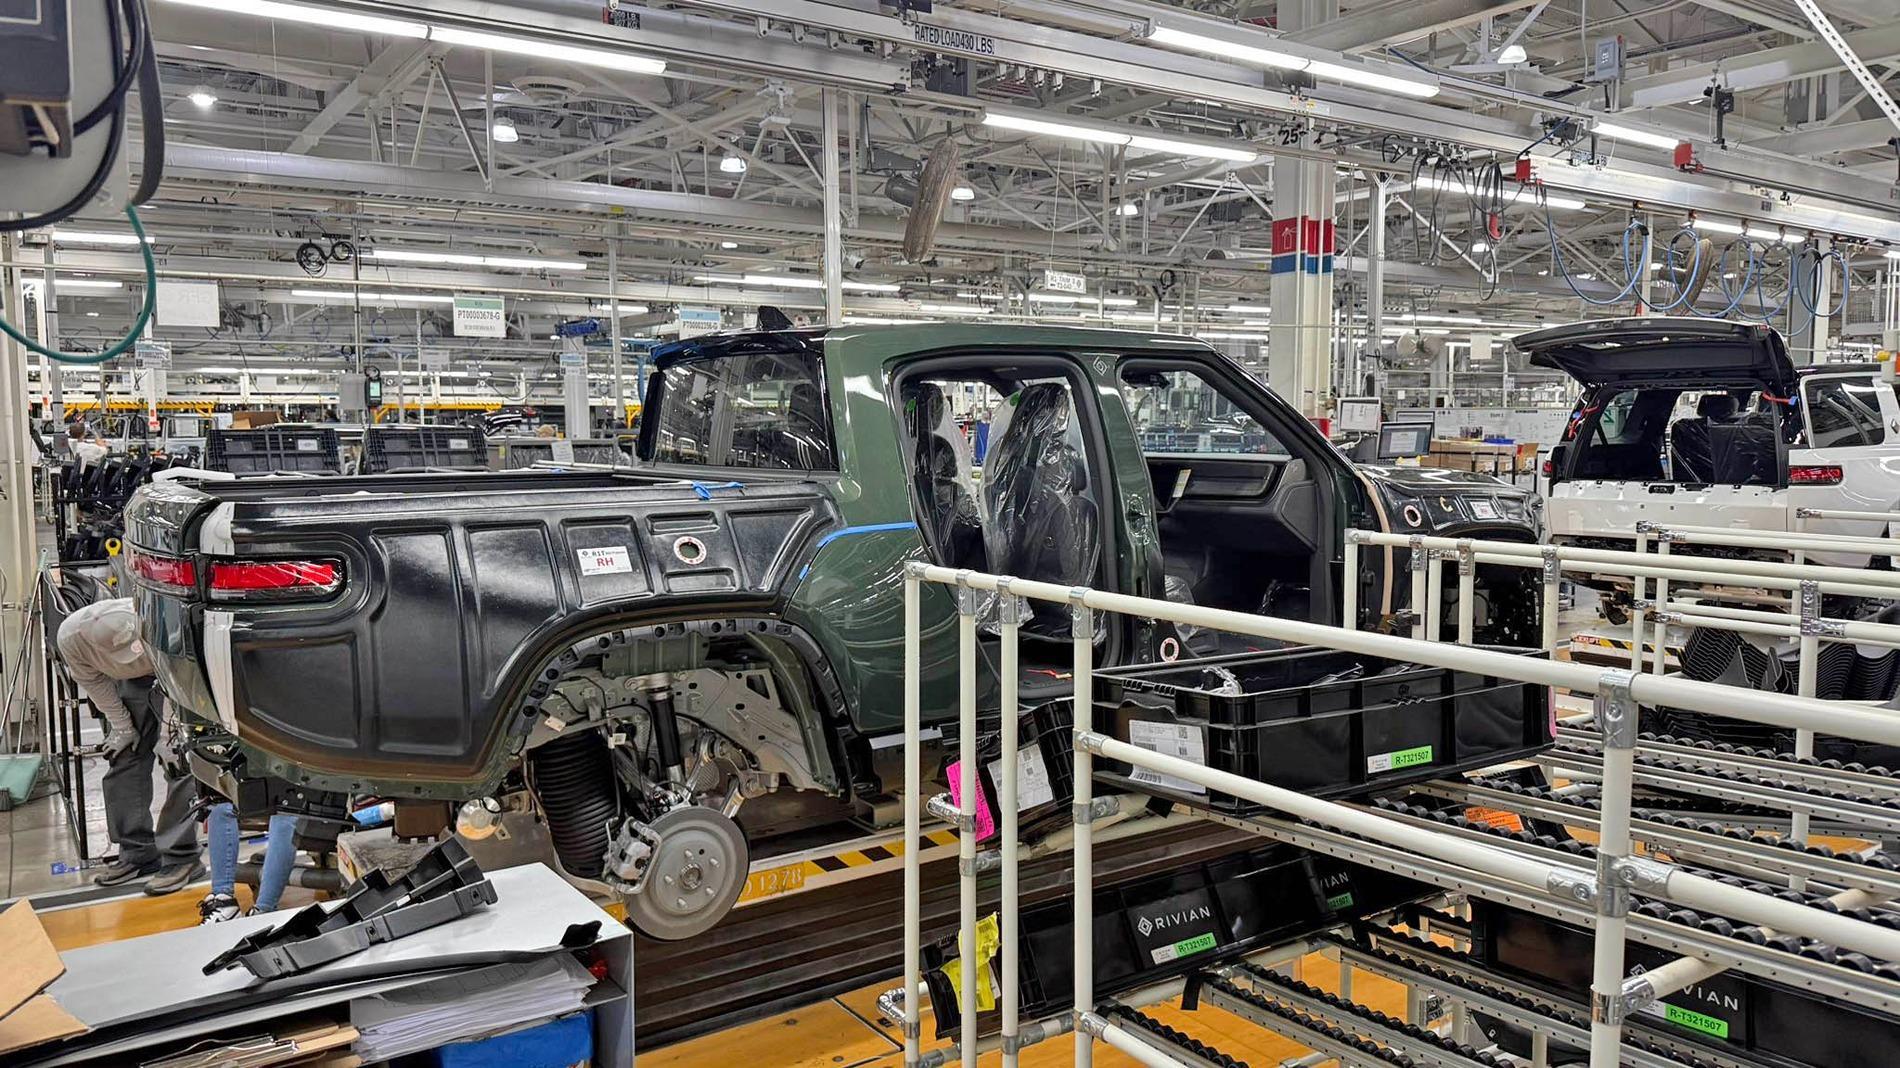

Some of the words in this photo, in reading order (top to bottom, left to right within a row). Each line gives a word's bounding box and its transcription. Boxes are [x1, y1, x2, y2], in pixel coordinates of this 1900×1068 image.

[915, 25, 939, 44] RATED
[976, 38, 995, 54] LBS.
[596, 557, 614, 567] RH
[1395, 751, 1428, 765] R-T321507
[1320, 871, 1349, 888] IAN
[1155, 906, 1211, 930] RIVIAN
[1178, 936, 1212, 953] R-T321507
[1683, 985, 1739, 1011] VIAN
[1670, 1008, 1722, 1032] R-T321507
